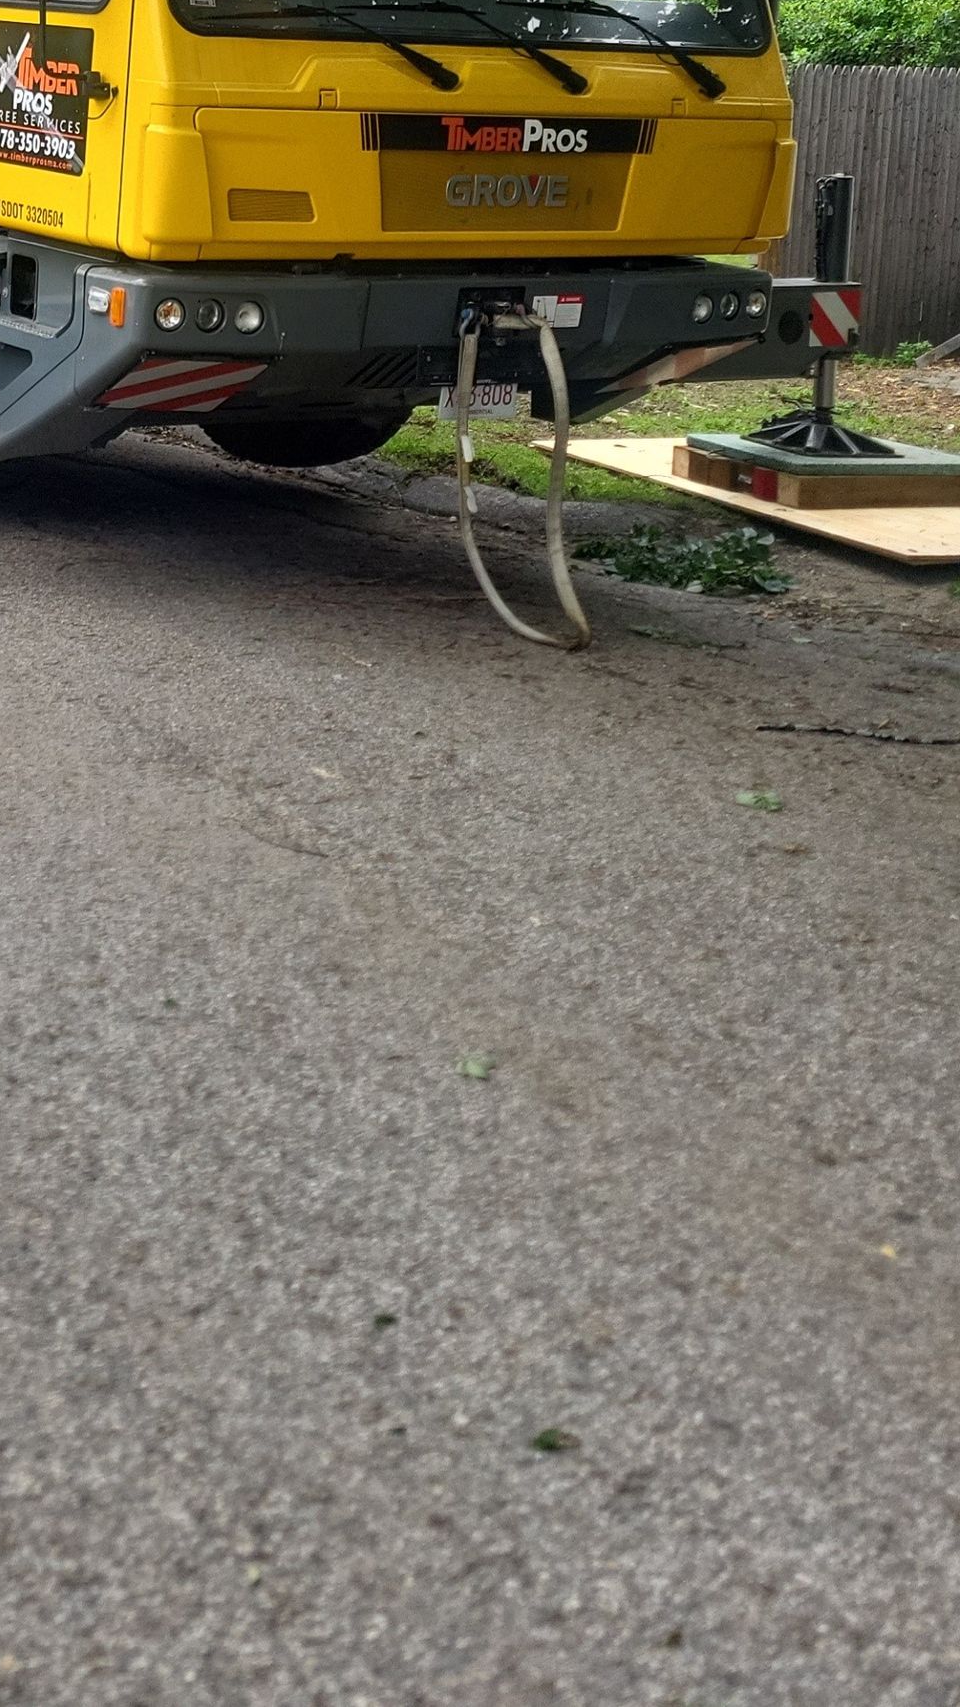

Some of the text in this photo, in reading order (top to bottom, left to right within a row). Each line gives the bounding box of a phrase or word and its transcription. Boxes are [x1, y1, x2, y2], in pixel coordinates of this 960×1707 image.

[13, 89, 53, 115] PROS
[23, 113, 81, 135] SERVICES
[445, 173, 569, 208] GROVE
[26, 205, 64, 228] 3320504
